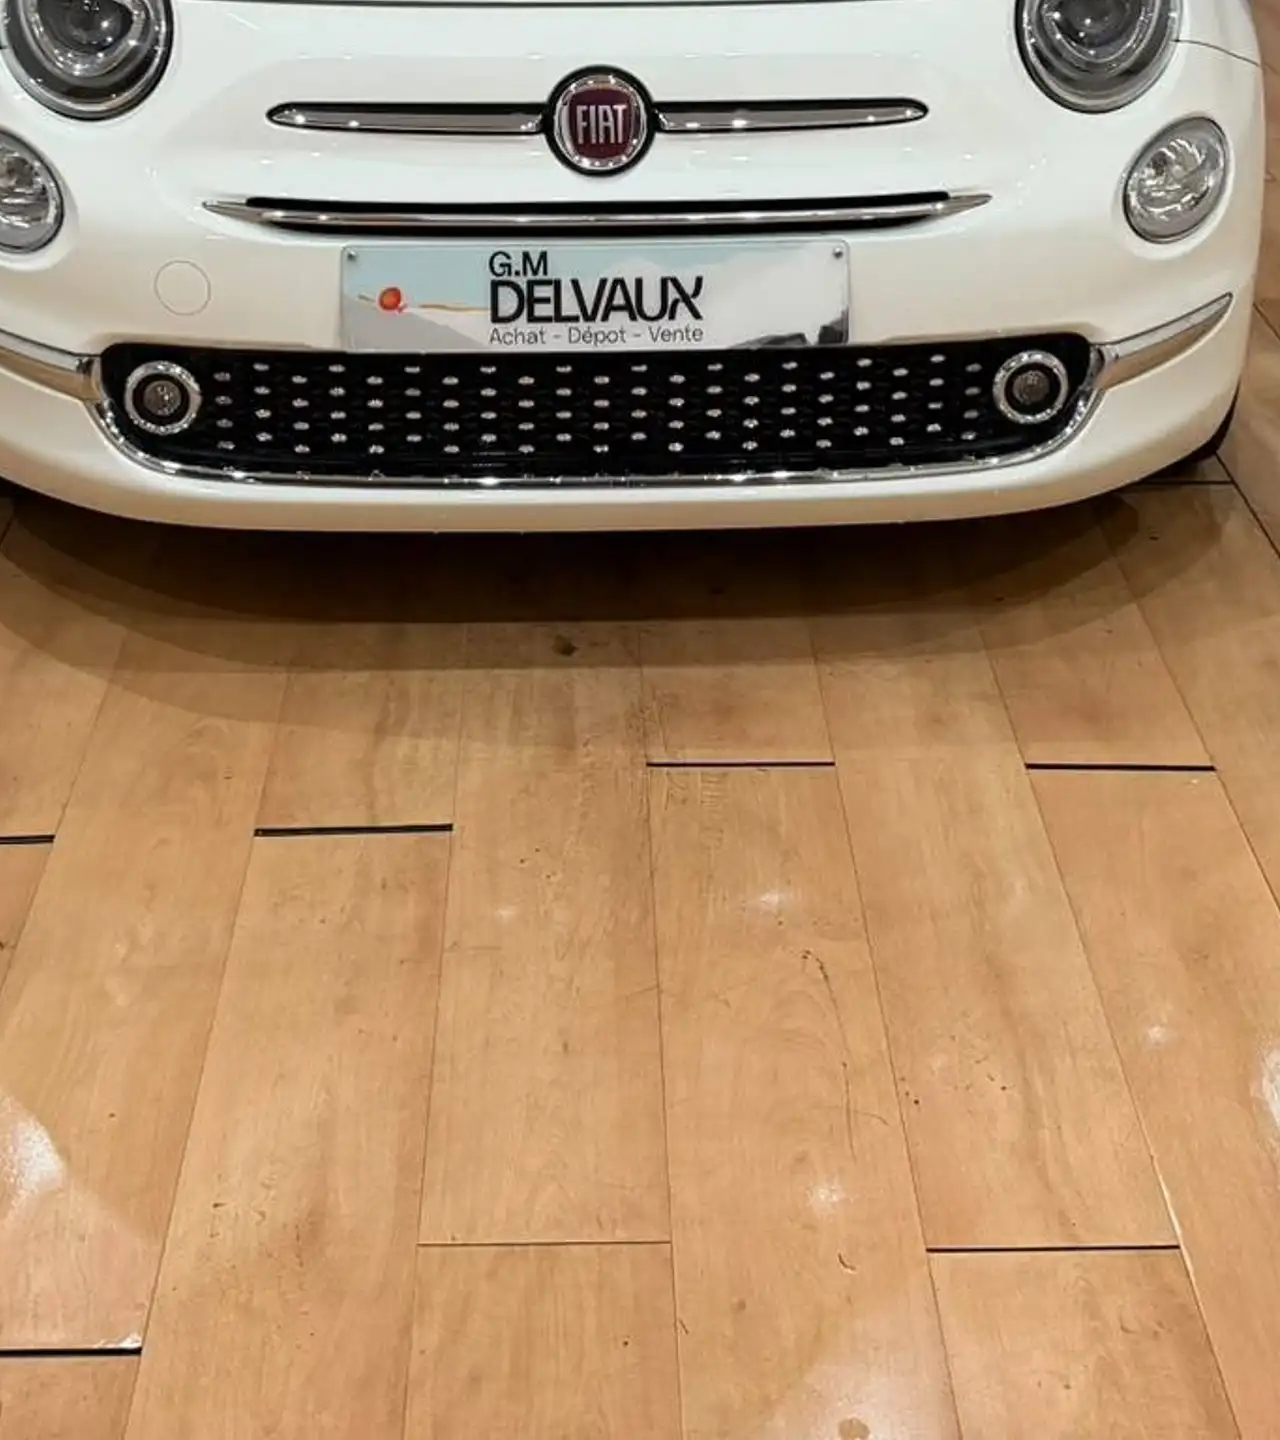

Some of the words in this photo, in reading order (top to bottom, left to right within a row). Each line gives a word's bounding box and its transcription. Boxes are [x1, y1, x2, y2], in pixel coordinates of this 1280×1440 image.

[576, 104, 627, 145] FIAT
[488, 250, 548, 277] G.M
[490, 276, 704, 323] DELVAUX
[489, 327, 547, 345] Achat
[648, 324, 704, 343] Vente
